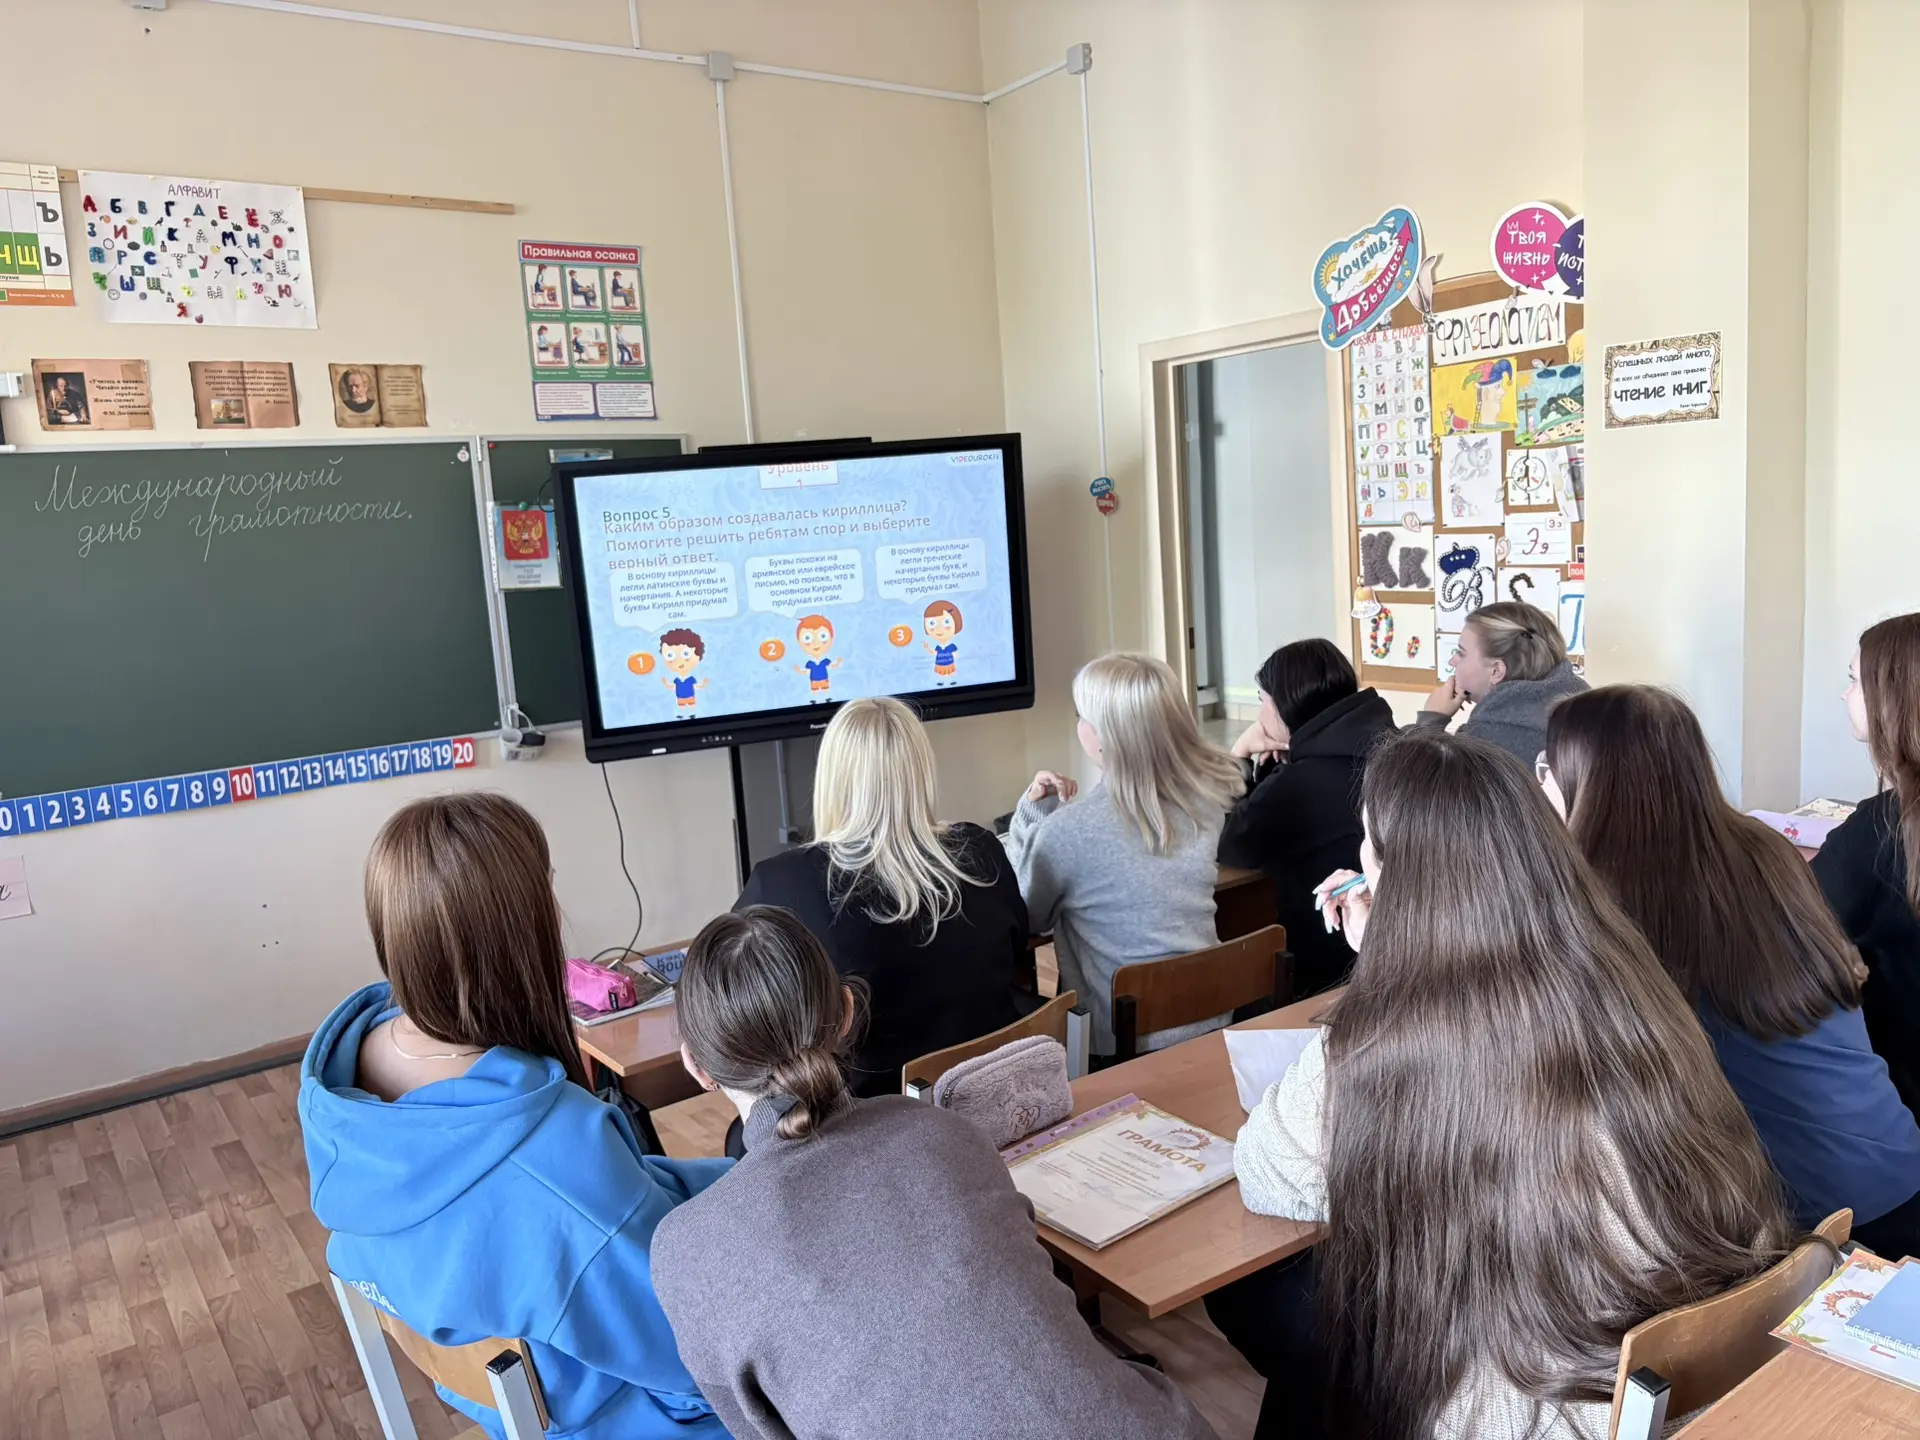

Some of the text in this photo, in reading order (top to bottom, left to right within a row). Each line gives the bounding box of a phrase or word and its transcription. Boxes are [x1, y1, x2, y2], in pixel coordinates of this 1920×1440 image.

[168, 184, 222, 200] АЛФАВИТ
[36, 202, 59, 223] Ъ
[83, 195, 260, 228] А Б В Г Е Ё
[114, 225, 283, 249] И Й К М Н О
[1509, 231, 1547, 245] ТВОЯ
[17, 245, 63, 271] Щ Ь
[117, 249, 239, 275] Р С У Ф
[524, 245, 637, 262] Правильная осанка
[1503, 251, 1550, 267] ЖИЗНЬ
[120, 275, 292, 298] Ш Ю
[1394, 340, 1403, 354] В
[1375, 357, 1425, 376] Е Ж
[1613, 349, 1713, 370] Успешных людей много,
[1357, 384, 1366, 399] З
[1614, 381, 1711, 402] чтение книг.
[1375, 396, 1424, 415] М О
[1358, 417, 1427, 440] П Р С Т
[1396, 440, 1429, 456] Х Ц
[768, 463, 829, 478] Уровень
[1376, 462, 1425, 479] Ш Щ Ъ
[35, 456, 343, 523] Международный
[796, 478, 803, 490] 1
[1397, 481, 1409, 502] Э
[603, 506, 671, 527] Вопрос 5
[604, 500, 907, 535] Каким образом создавалась кириллица?
[78, 520, 141, 558] день
[188, 500, 413, 562] грамотности.
[606, 516, 932, 552] Помогите решить ребятам спор и выберите
[890, 542, 971, 558] В основу кириллицы
[900, 553, 963, 565] легли греческие
[609, 552, 718, 570] верный ответ.
[769, 554, 838, 569] Буквы похожи на
[895, 562, 969, 576] начертания букв, и
[627, 567, 717, 583] В основу кириллицы
[752, 562, 856, 580] армянское или еврейское
[884, 570, 980, 588] некоторые буквы Кирилл
[620, 576, 726, 593] легли латинские буквы и
[754, 578, 788, 589] письмо,
[789, 577, 800, 585] но
[801, 575, 832, 586] похоже,
[833, 573, 848, 581] что
[905, 582, 961, 596] придумал сам.
[620, 586, 729, 604] начертания. А некоторые
[770, 583, 842, 598] основном Кирилл
[623, 596, 728, 615] буквы Кирилл придумал
[772, 596, 812, 608] придумал
[825, 594, 842, 602] сам.
[667, 611, 686, 620] сам.
[896, 628, 905, 641] 3
[767, 644, 776, 656] 2
[637, 657, 646, 669] 1
[0, 741, 474, 831] 0 1 2 3 4 5 6 7 8 9 10 11 12 13 14 15 16 17 18 19 20
[1116, 1129, 1206, 1172] ГРАМОТА
